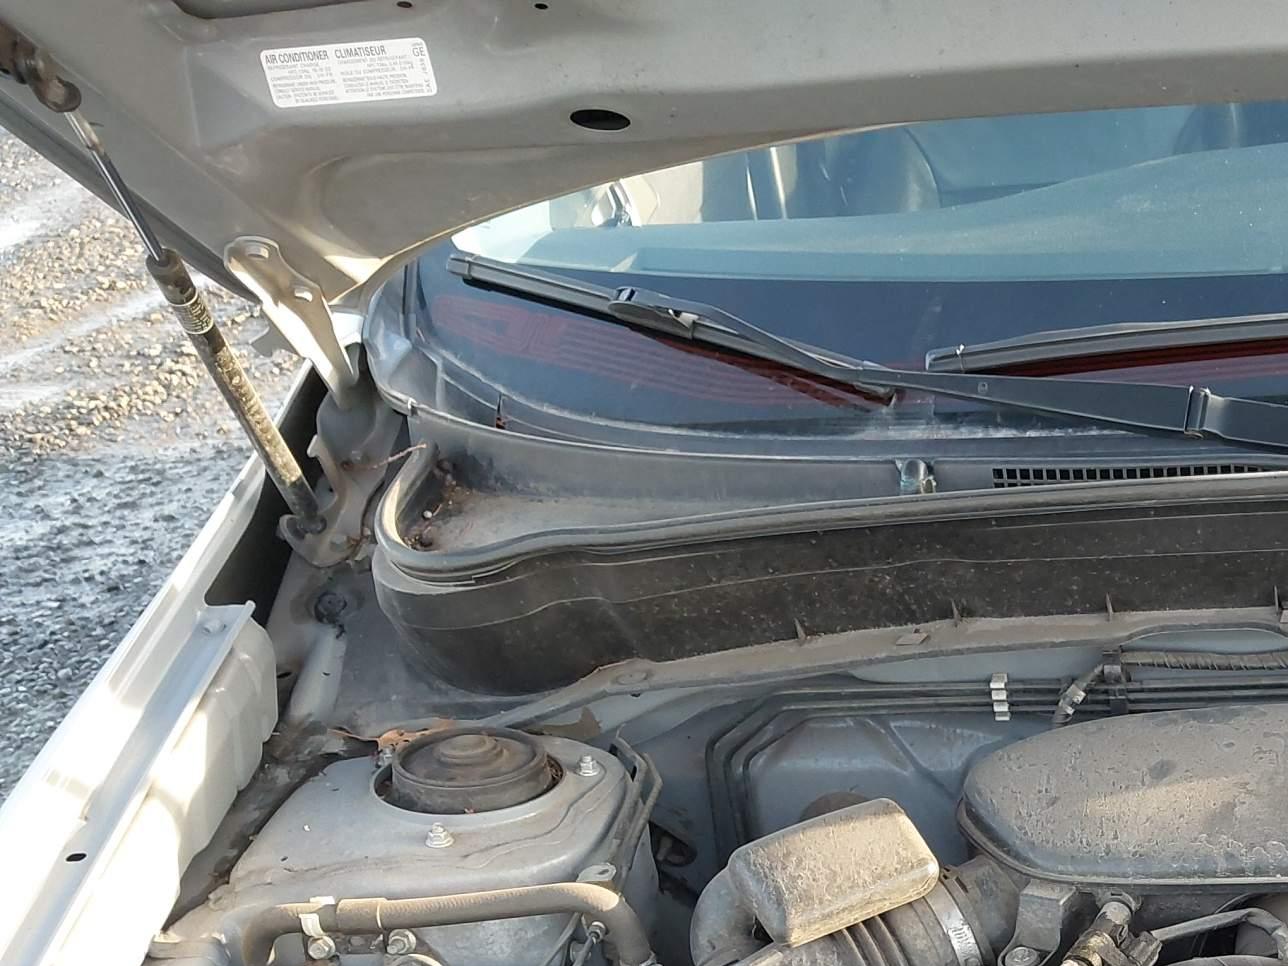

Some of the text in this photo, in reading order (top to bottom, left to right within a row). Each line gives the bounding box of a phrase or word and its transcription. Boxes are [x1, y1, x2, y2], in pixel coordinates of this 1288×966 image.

[265, 54, 278, 64] AIR
[278, 50, 329, 64] CONDITIONER
[335, 45, 387, 59] CLIMATISEUR
[412, 46, 425, 57] GE
